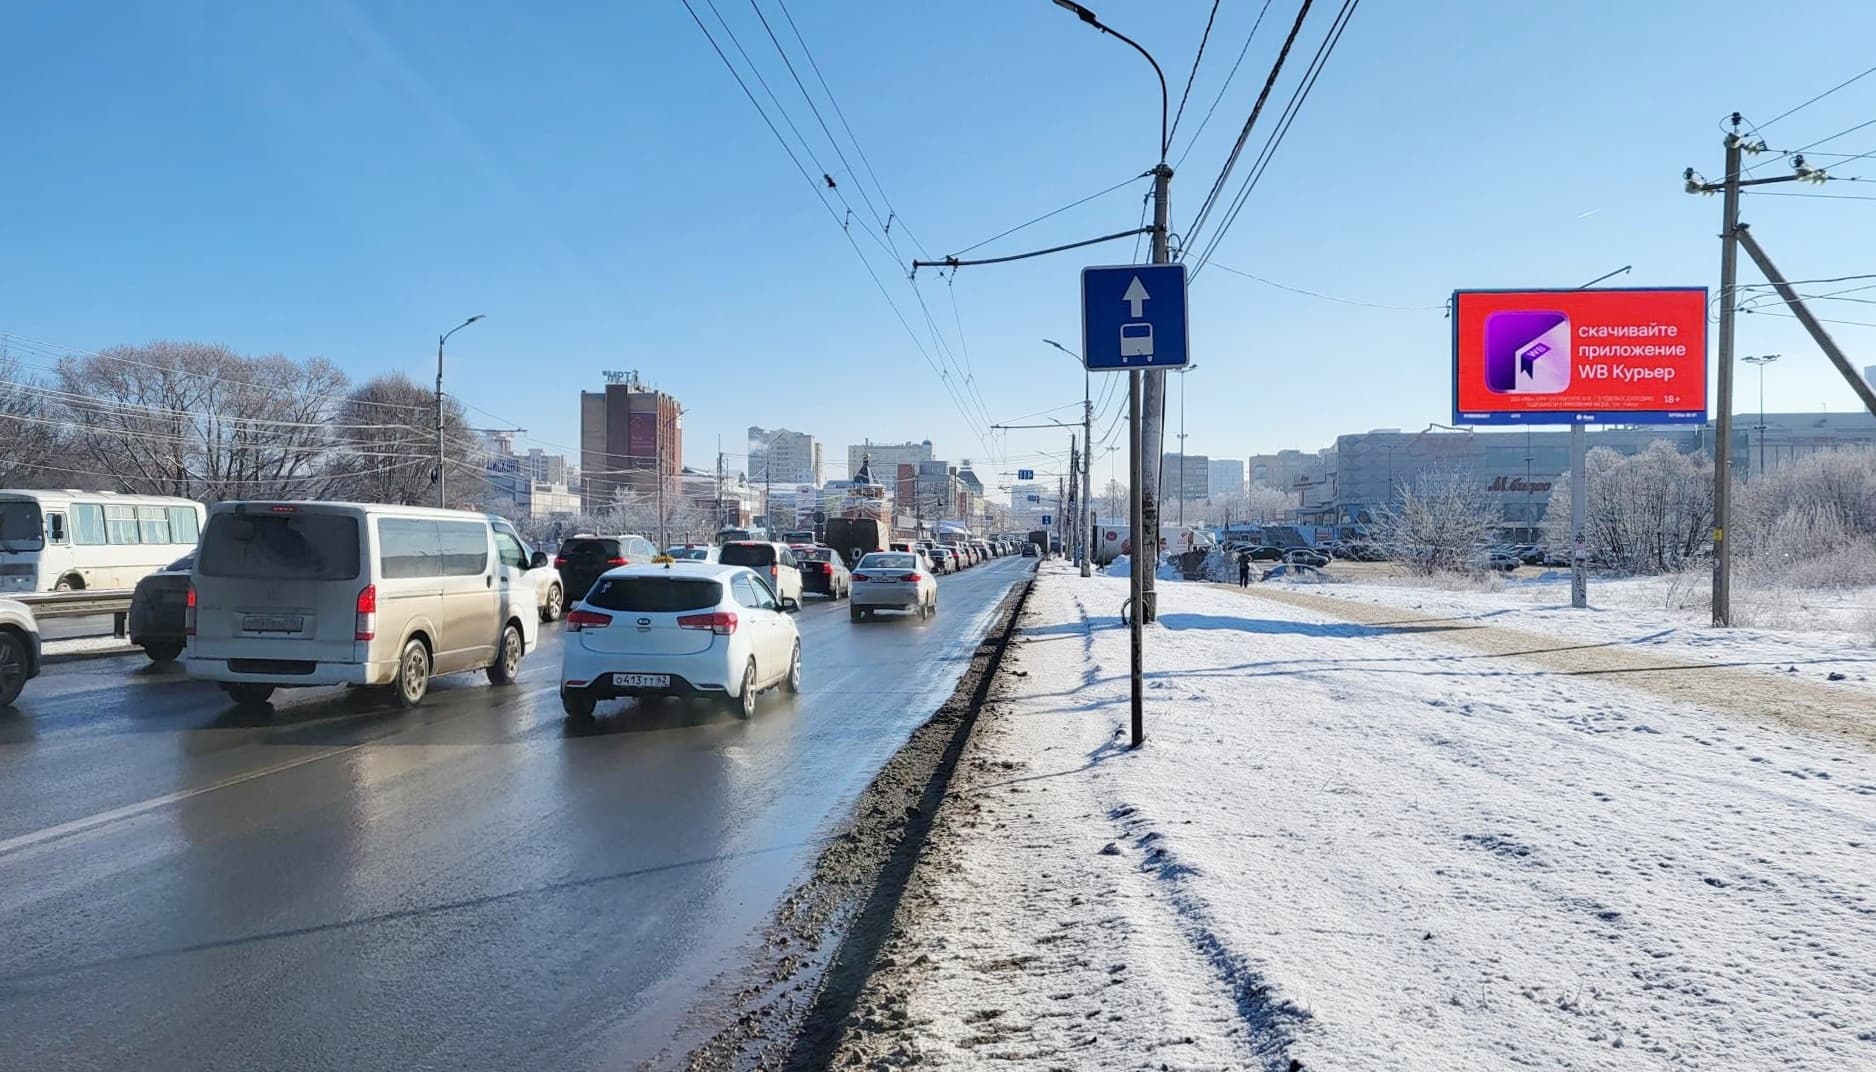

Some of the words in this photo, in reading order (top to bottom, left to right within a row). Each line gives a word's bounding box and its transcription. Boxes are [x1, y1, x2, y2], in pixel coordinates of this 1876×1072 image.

[1578, 322, 1678, 337] скачивайте
[1525, 345, 1547, 358] WB
[1578, 344, 1687, 360] приложение
[1578, 363, 1608, 379] WB
[1612, 363, 1676, 383] Курьер
[1663, 394, 1681, 405] 18+
